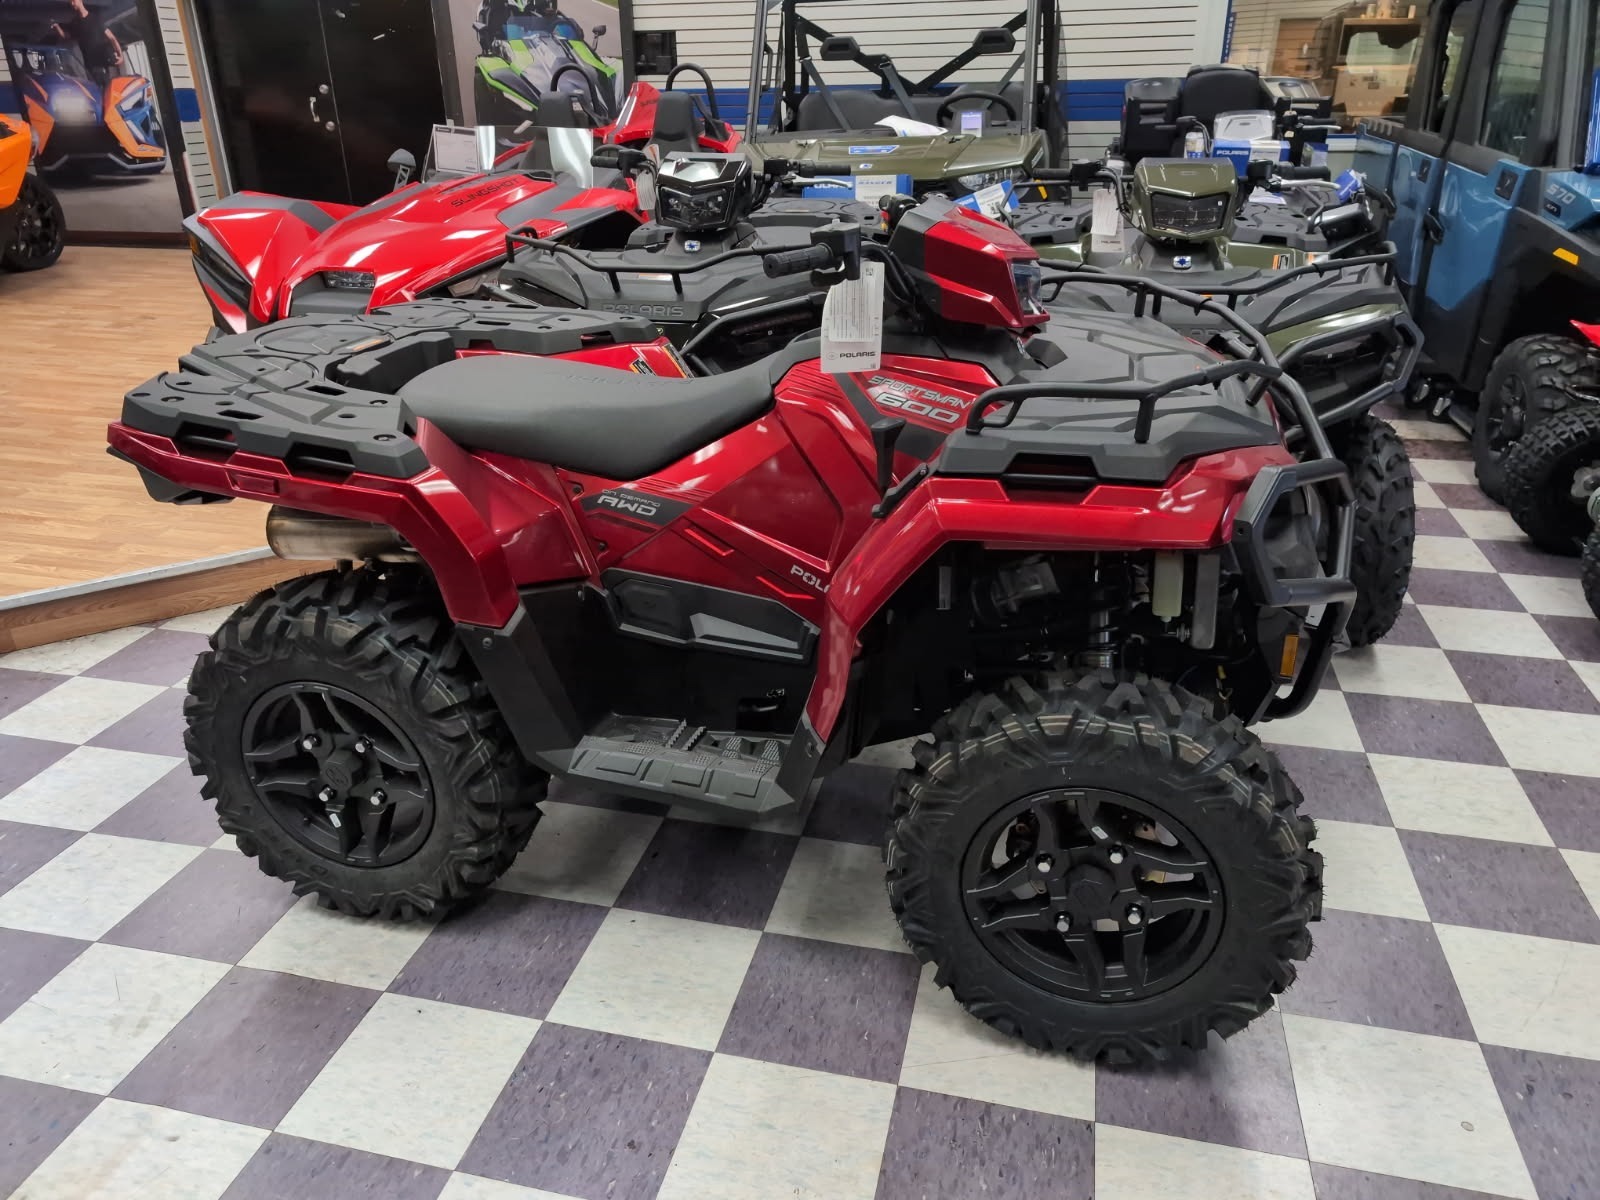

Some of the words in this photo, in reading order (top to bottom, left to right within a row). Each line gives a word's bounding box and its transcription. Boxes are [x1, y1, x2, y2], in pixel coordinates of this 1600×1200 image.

[450, 178, 518, 207] SLINGSHOT
[1546, 183, 1577, 205] 570
[603, 303, 685, 317] POLARIS
[839, 351, 876, 359] POLARIS
[868, 375, 971, 409] SPORTSMAN
[875, 391, 960, 424] 600
[596, 494, 657, 516] AWD
